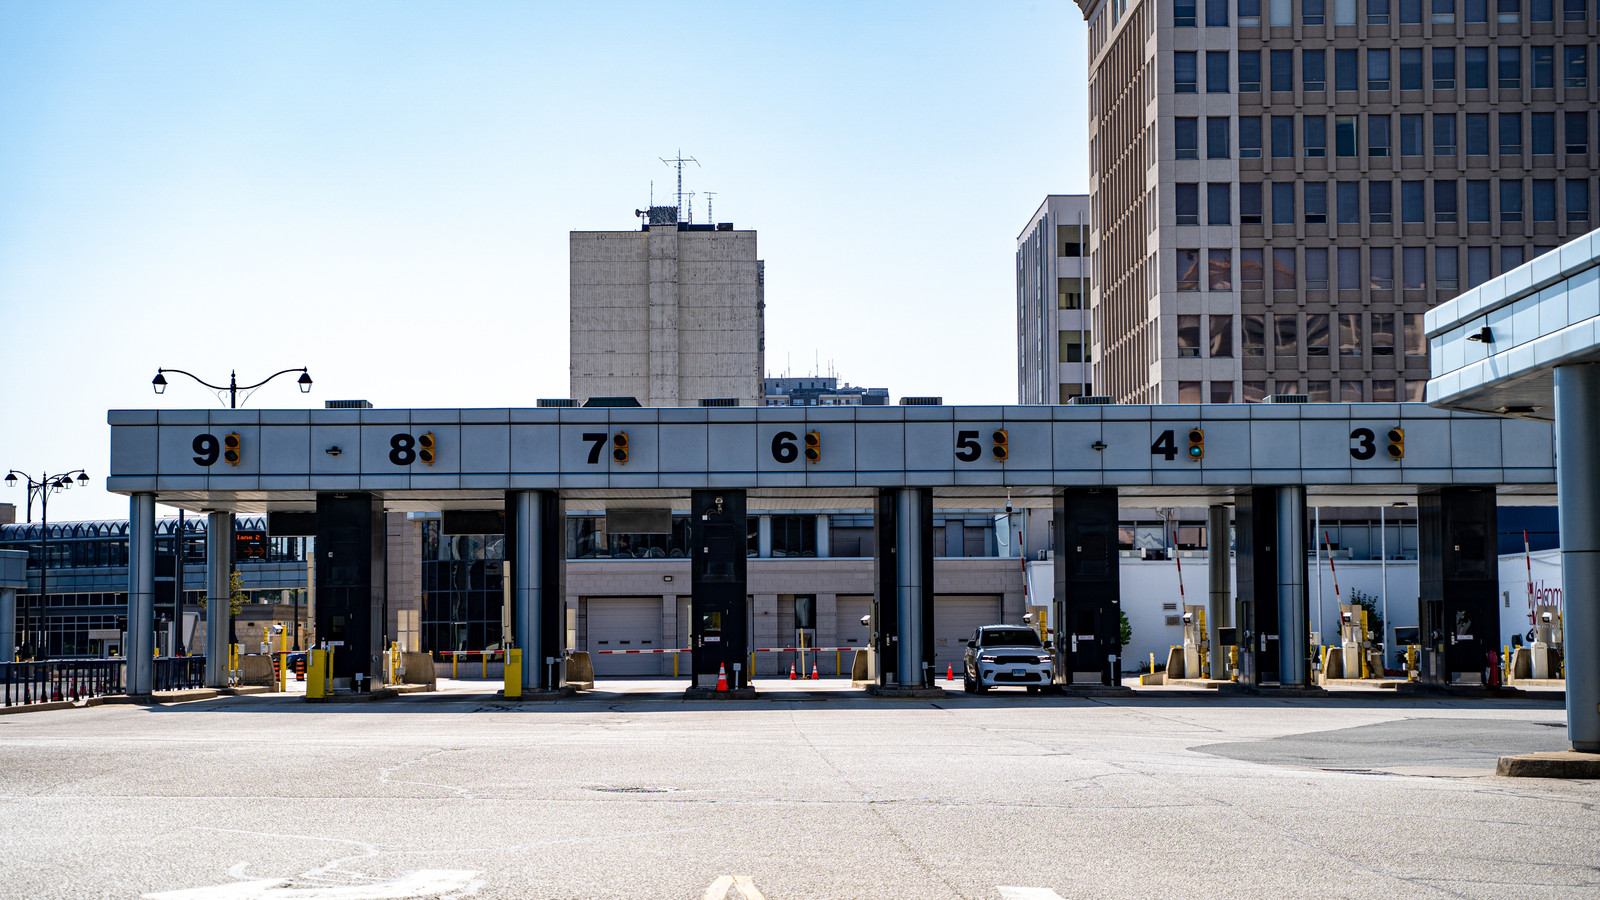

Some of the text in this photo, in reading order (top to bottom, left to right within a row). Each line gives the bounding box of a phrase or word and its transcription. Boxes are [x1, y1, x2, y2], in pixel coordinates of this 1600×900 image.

[192, 434, 220, 466] 9
[390, 433, 417, 466] 8
[583, 433, 607, 464] 7
[771, 432, 798, 464] 6
[955, 431, 981, 463] 5
[1151, 430, 1179, 461] 4
[1350, 428, 1377, 460] 3
